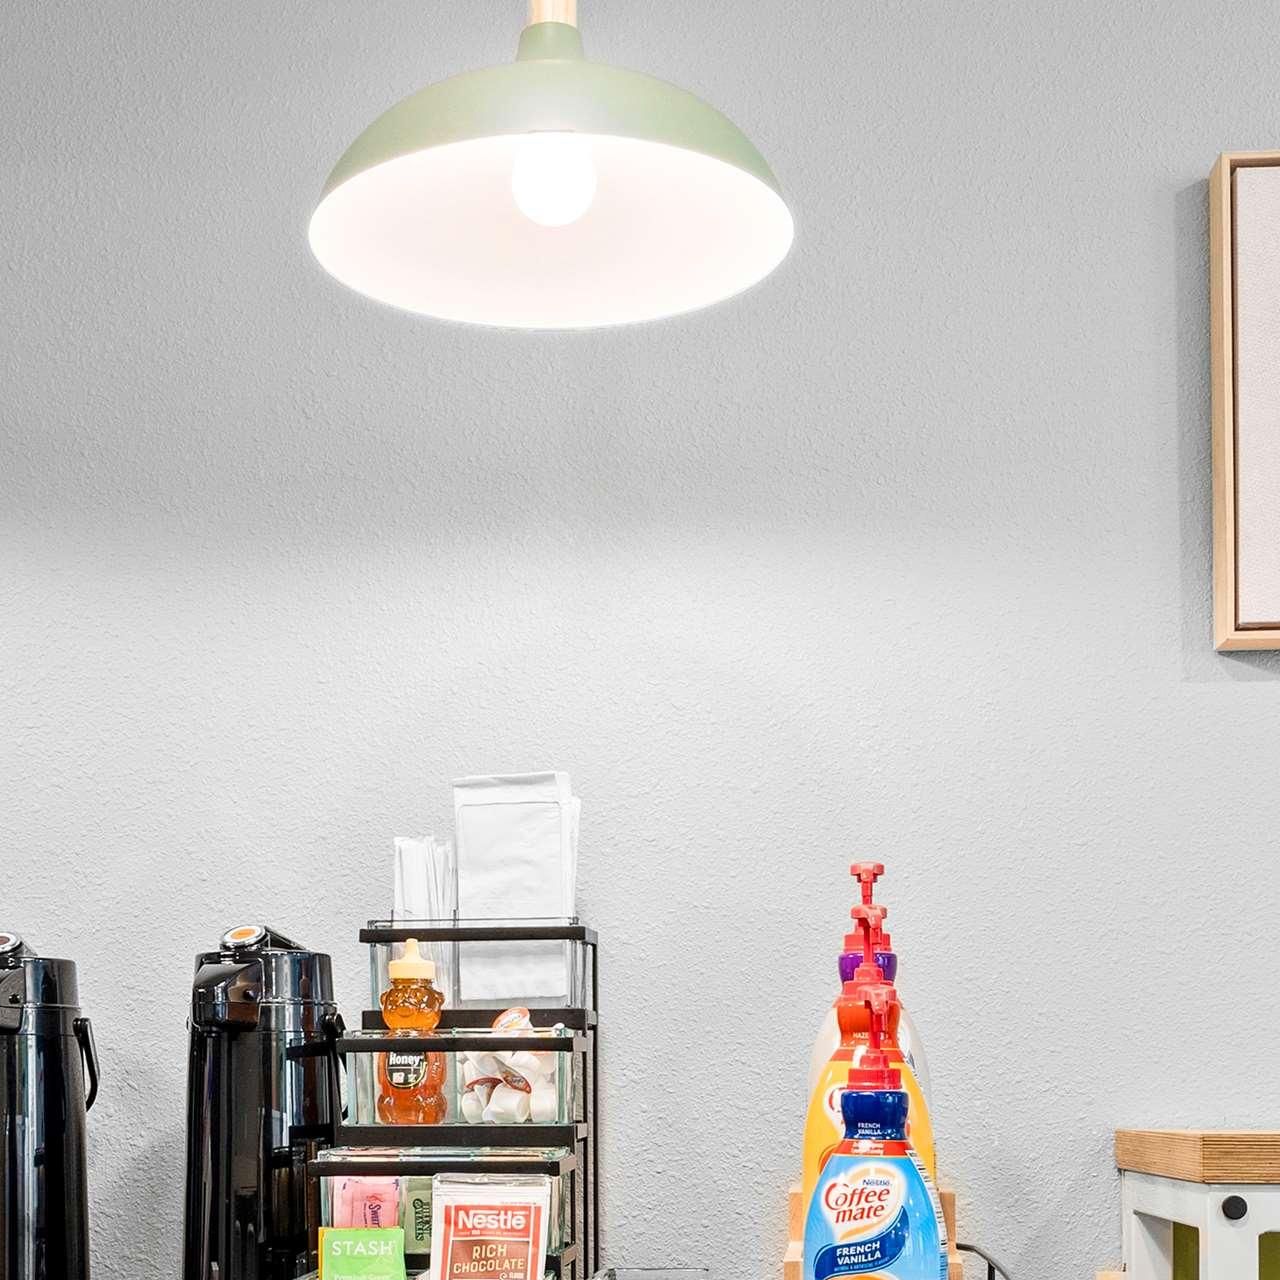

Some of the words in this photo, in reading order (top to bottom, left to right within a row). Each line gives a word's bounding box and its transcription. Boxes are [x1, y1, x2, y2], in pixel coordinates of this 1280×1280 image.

[389, 1052, 422, 1067] Honey
[824, 1183, 891, 1210] Coffee
[835, 1204, 886, 1223] mate
[332, 1241, 393, 1256] STASH
[472, 1244, 507, 1260] RICH
[836, 1241, 881, 1256] FRENCH
[837, 1251, 882, 1265] VANILLA
[453, 1259, 525, 1274] CHOCOLATE
